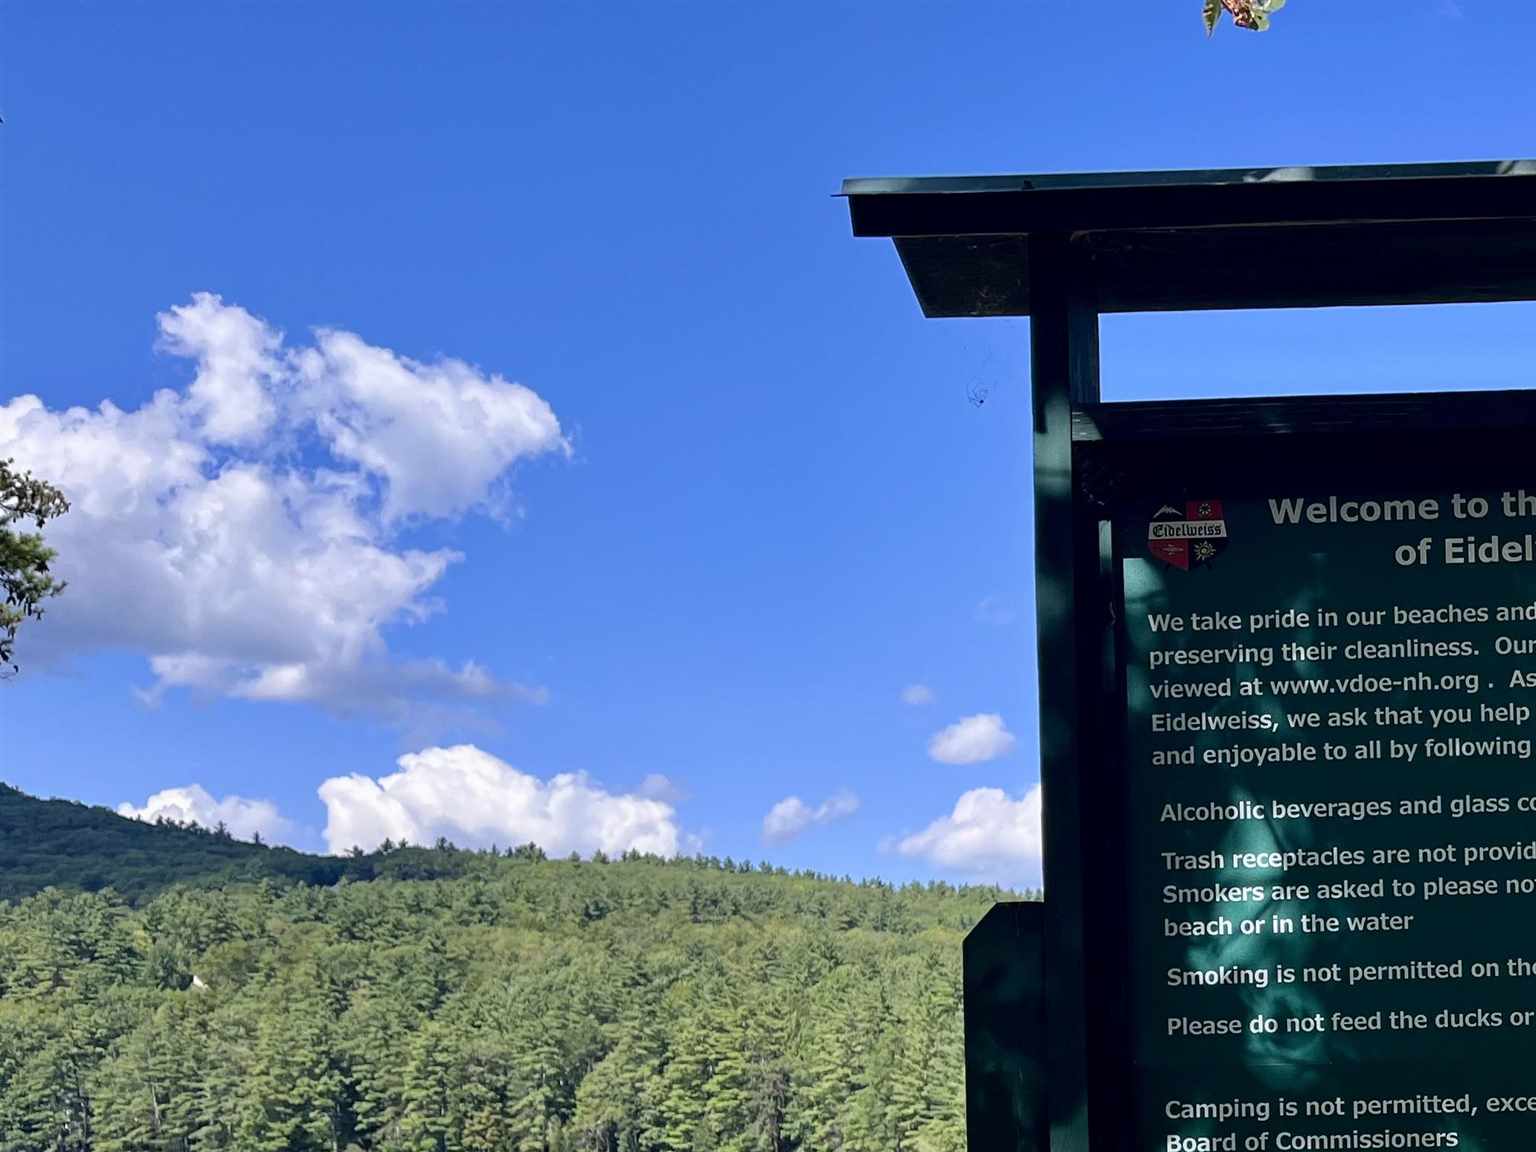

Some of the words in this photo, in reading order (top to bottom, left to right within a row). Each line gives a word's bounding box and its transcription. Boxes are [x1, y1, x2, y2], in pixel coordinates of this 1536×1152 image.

[1267, 494, 1439, 525] Welcome
[1450, 492, 1489, 519] to
[1152, 522, 1221, 537] Eidelweiss
[1394, 536, 1432, 566] of
[1148, 677, 1231, 699] viewed
[1238, 676, 1263, 696] at
[1269, 670, 1479, 695] www.vdoe-nh.org
[1487, 681, 1494, 689] .
[1159, 799, 1265, 822] Alcoholic
[1271, 799, 1392, 821] beverages
[1398, 794, 1442, 815] and
[1449, 793, 1510, 818] glass
[1163, 915, 1233, 937] beach
[1239, 918, 1266, 935] or
[1271, 913, 1294, 934] in
[1299, 912, 1340, 933] the
[1345, 911, 1414, 931] water
[1166, 964, 1268, 988] Smoking
[1275, 963, 1295, 983] is
[1302, 962, 1342, 982] not
[1348, 958, 1463, 985] permitted
[1470, 961, 1499, 978] on
